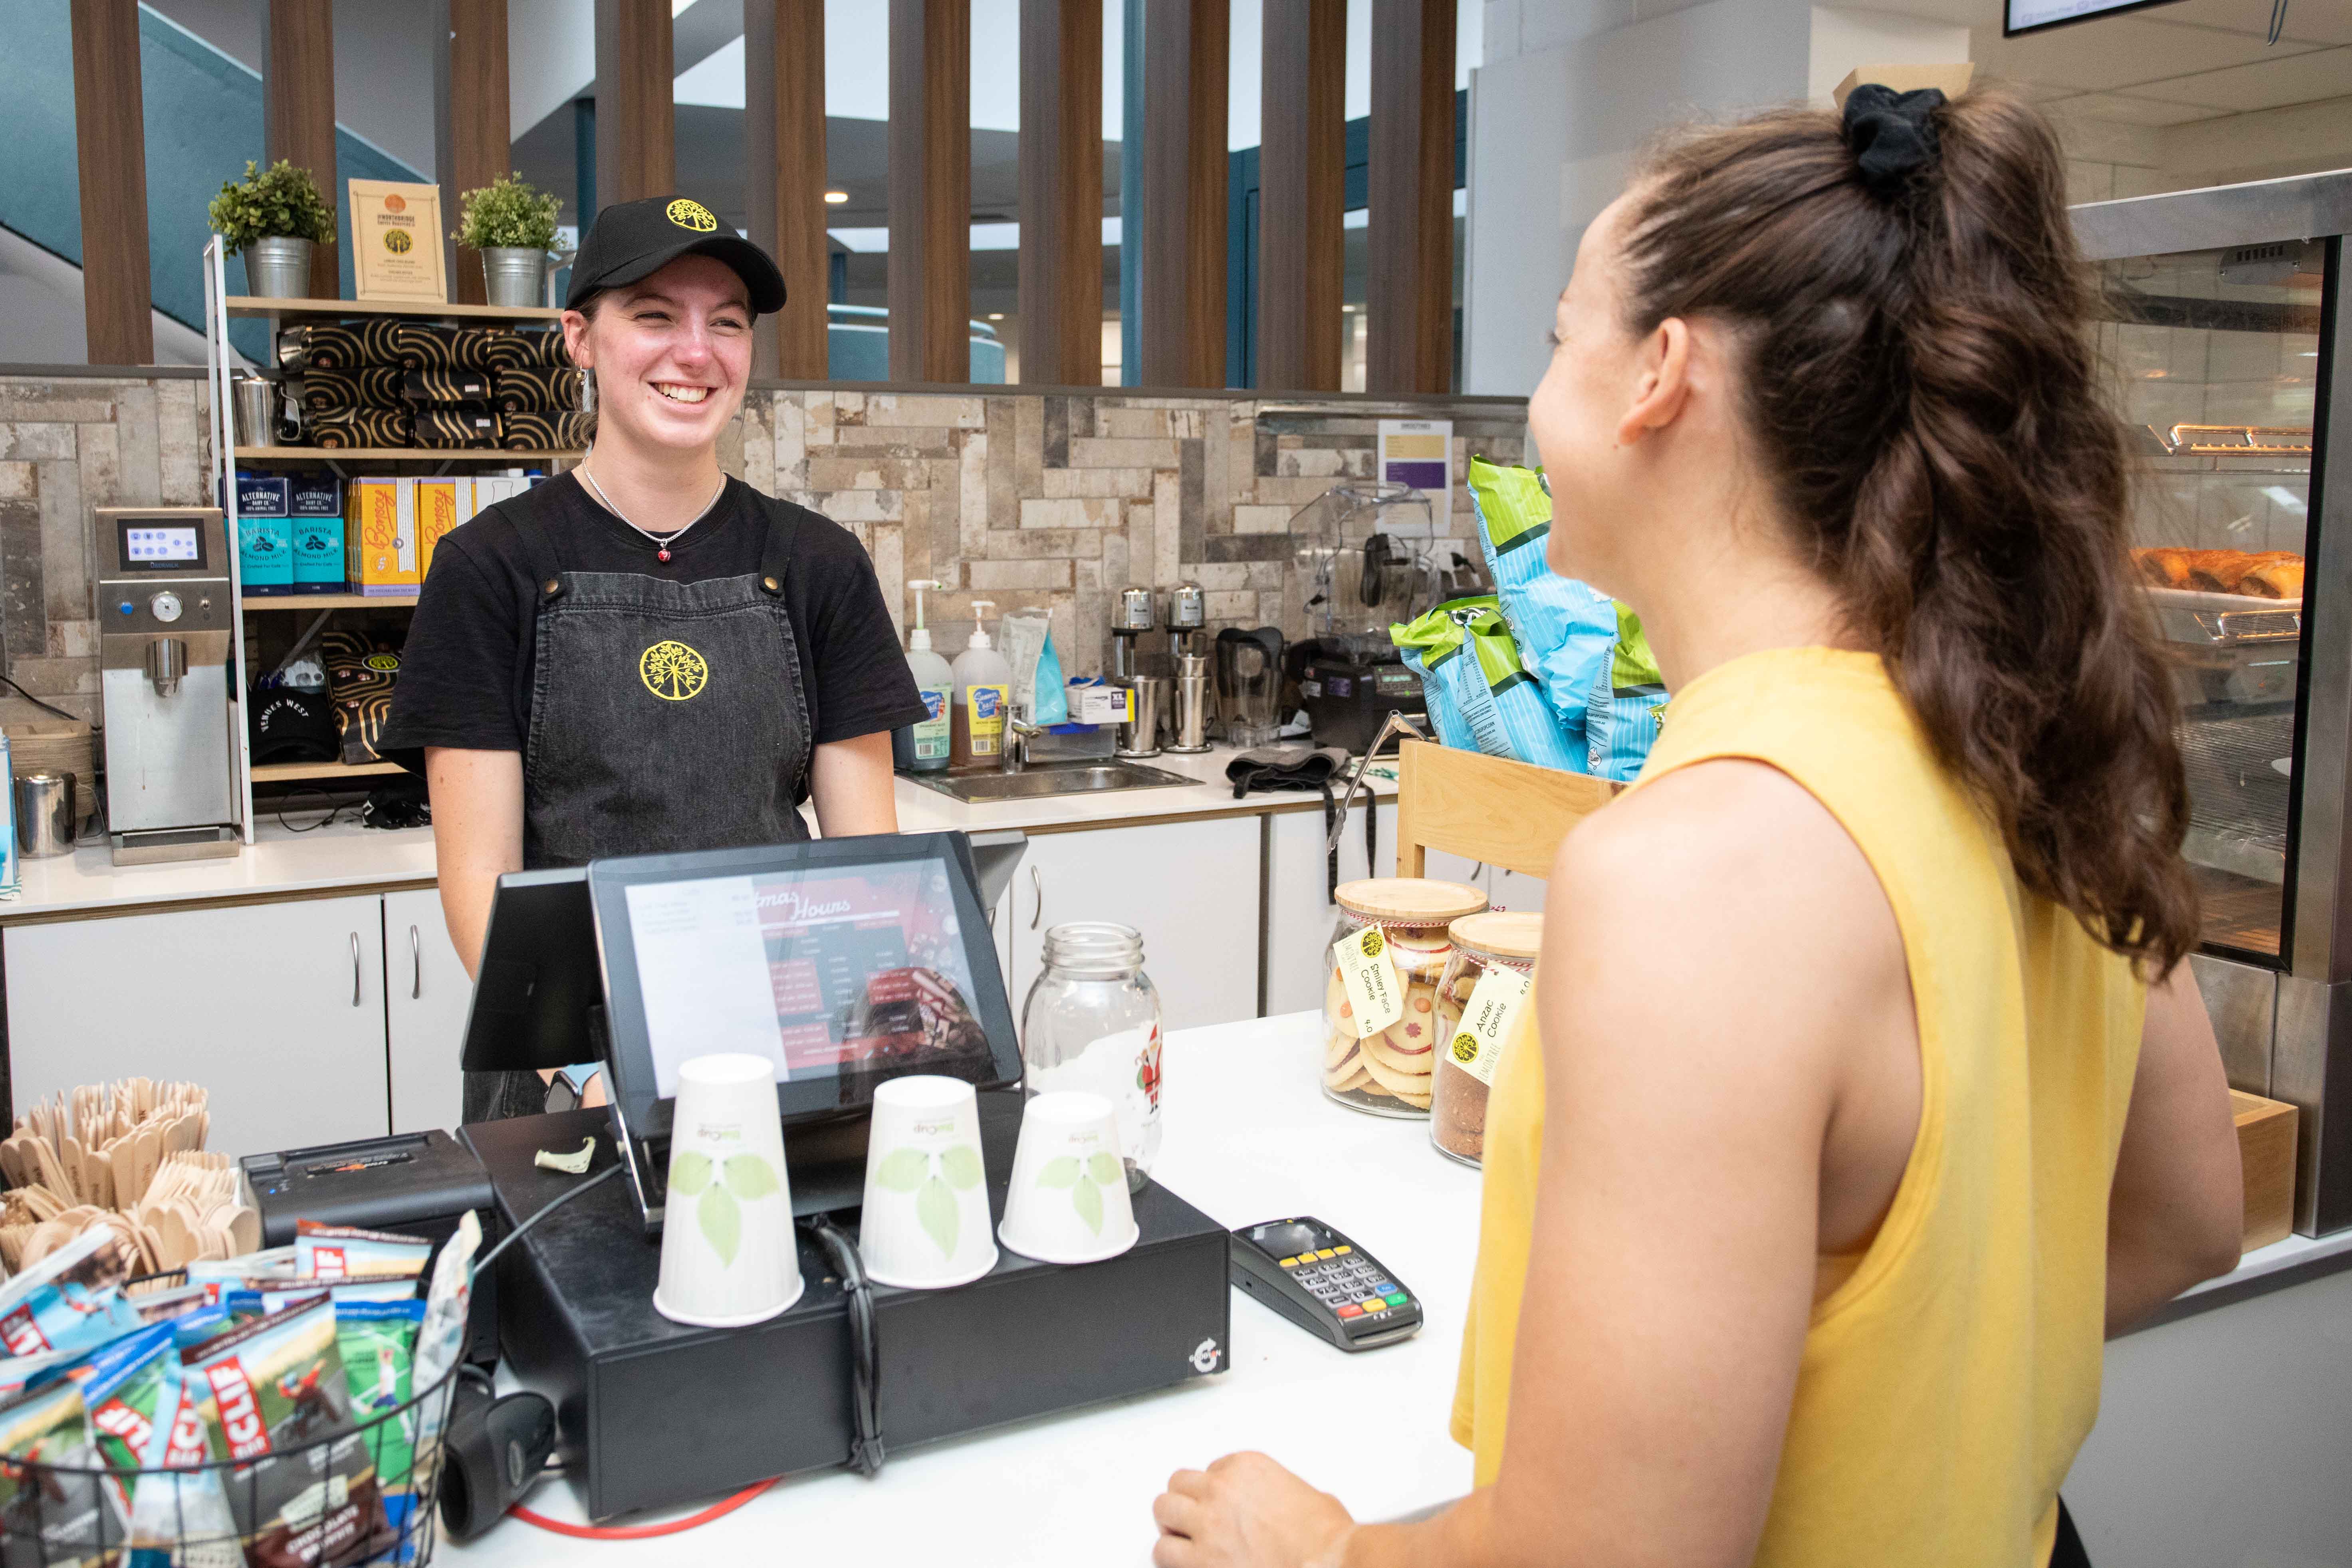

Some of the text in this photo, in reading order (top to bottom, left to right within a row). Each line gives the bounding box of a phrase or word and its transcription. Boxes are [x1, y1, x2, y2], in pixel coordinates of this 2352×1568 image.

[242, 492, 280, 502] ALTERNATIVE
[296, 492, 333, 502] ALTERNATIVE
[246, 527, 280, 537] BARISTA
[299, 527, 332, 535] BARISTA
[240, 549, 286, 561] ALMOND MILK
[294, 547, 338, 559] ALMOND MILK
[261, 698, 309, 733] VENUES WEST
[789, 898, 851, 921] Hours
[1361, 969, 1375, 1001] Cookie
[1370, 963, 1391, 1014] Smiley Face
[1364, 1019, 1373, 1033] 4.0
[1477, 999, 1494, 1032] Anzac
[1487, 1003, 1507, 1038] Cookie
[210, 1366, 260, 1445] CLIF
[299, 1522, 356, 1563] BRWNIE
